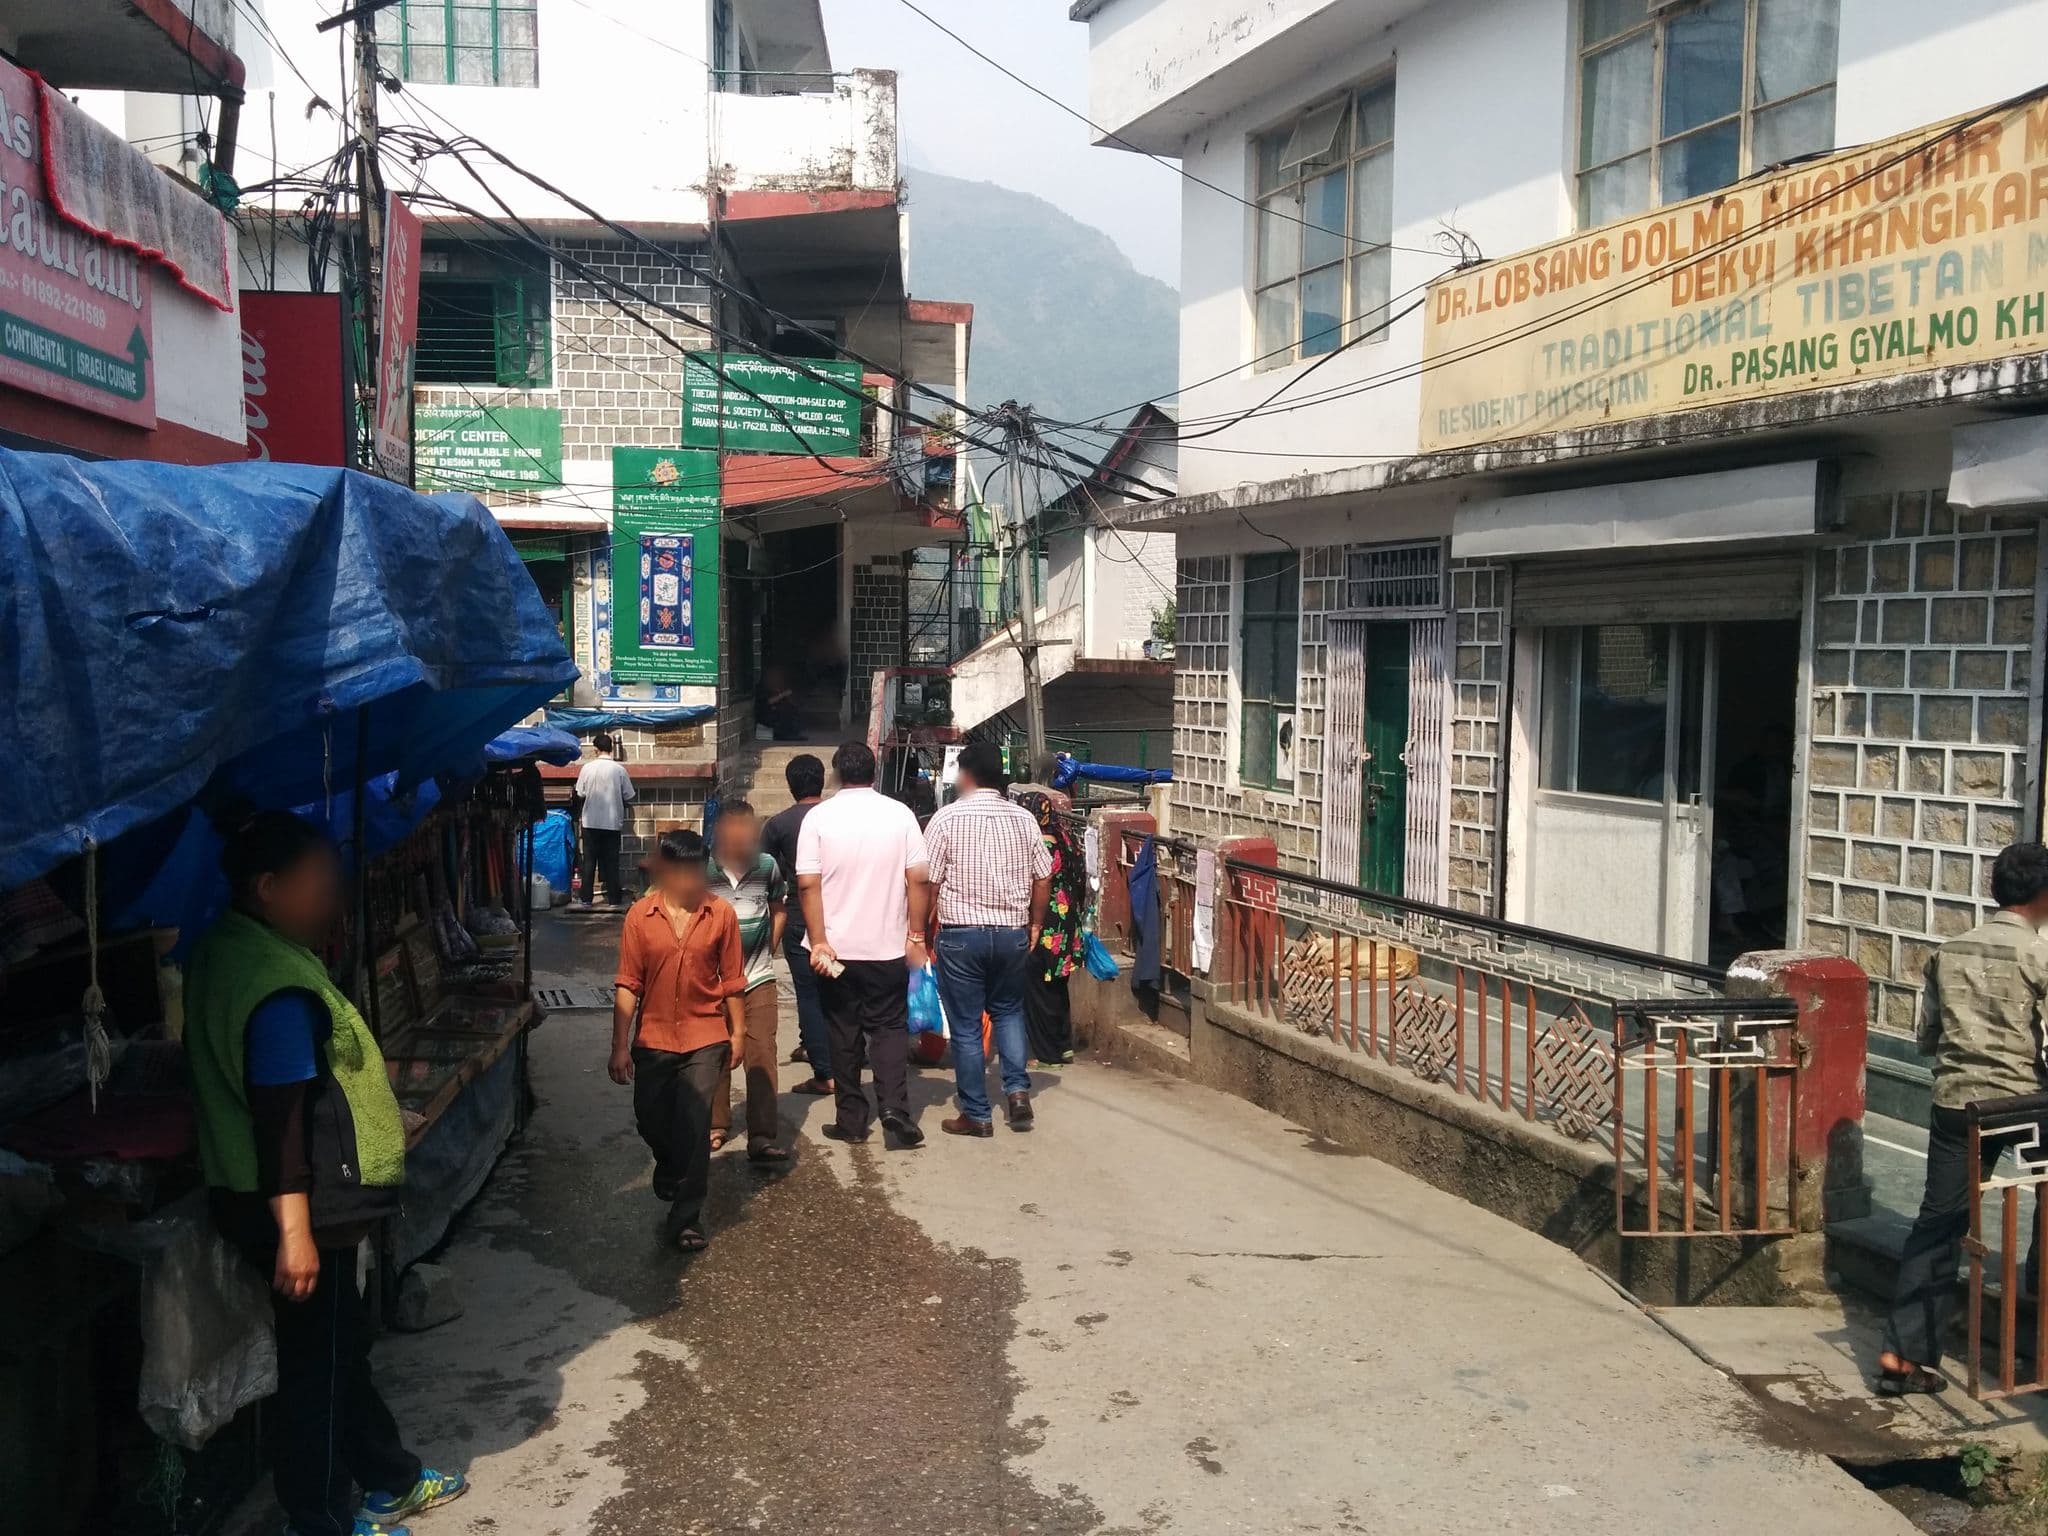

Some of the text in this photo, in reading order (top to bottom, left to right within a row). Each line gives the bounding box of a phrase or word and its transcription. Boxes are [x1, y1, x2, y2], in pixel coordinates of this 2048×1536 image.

[1475, 237, 1609, 313] LOBSANG
[1622, 198, 1745, 272] DOLMA
[1761, 121, 2001, 232] KHANGKAR
[1542, 295, 1772, 380] TRADITIONAL
[1797, 238, 2003, 328] TIBETAN
[5, 322, 66, 368] CONTINENTAL
[77, 350, 107, 383] ISRAELI
[108, 361, 137, 394] CUISINE
[1683, 362, 1724, 395] DR.
[1731, 333, 1838, 386] PASANG
[1850, 306, 1978, 365] GYALMO
[733, 406, 762, 417] SOCIETY
[1438, 392, 1529, 436] RESIDENT
[461, 430, 509, 442] CENTER
[439, 458, 474, 467] DESIGN
[478, 458, 502, 467] RUGS
[455, 447, 509, 458] AVAILABLE
[513, 448, 542, 458] HERE
[489, 469, 516, 479] SINCE
